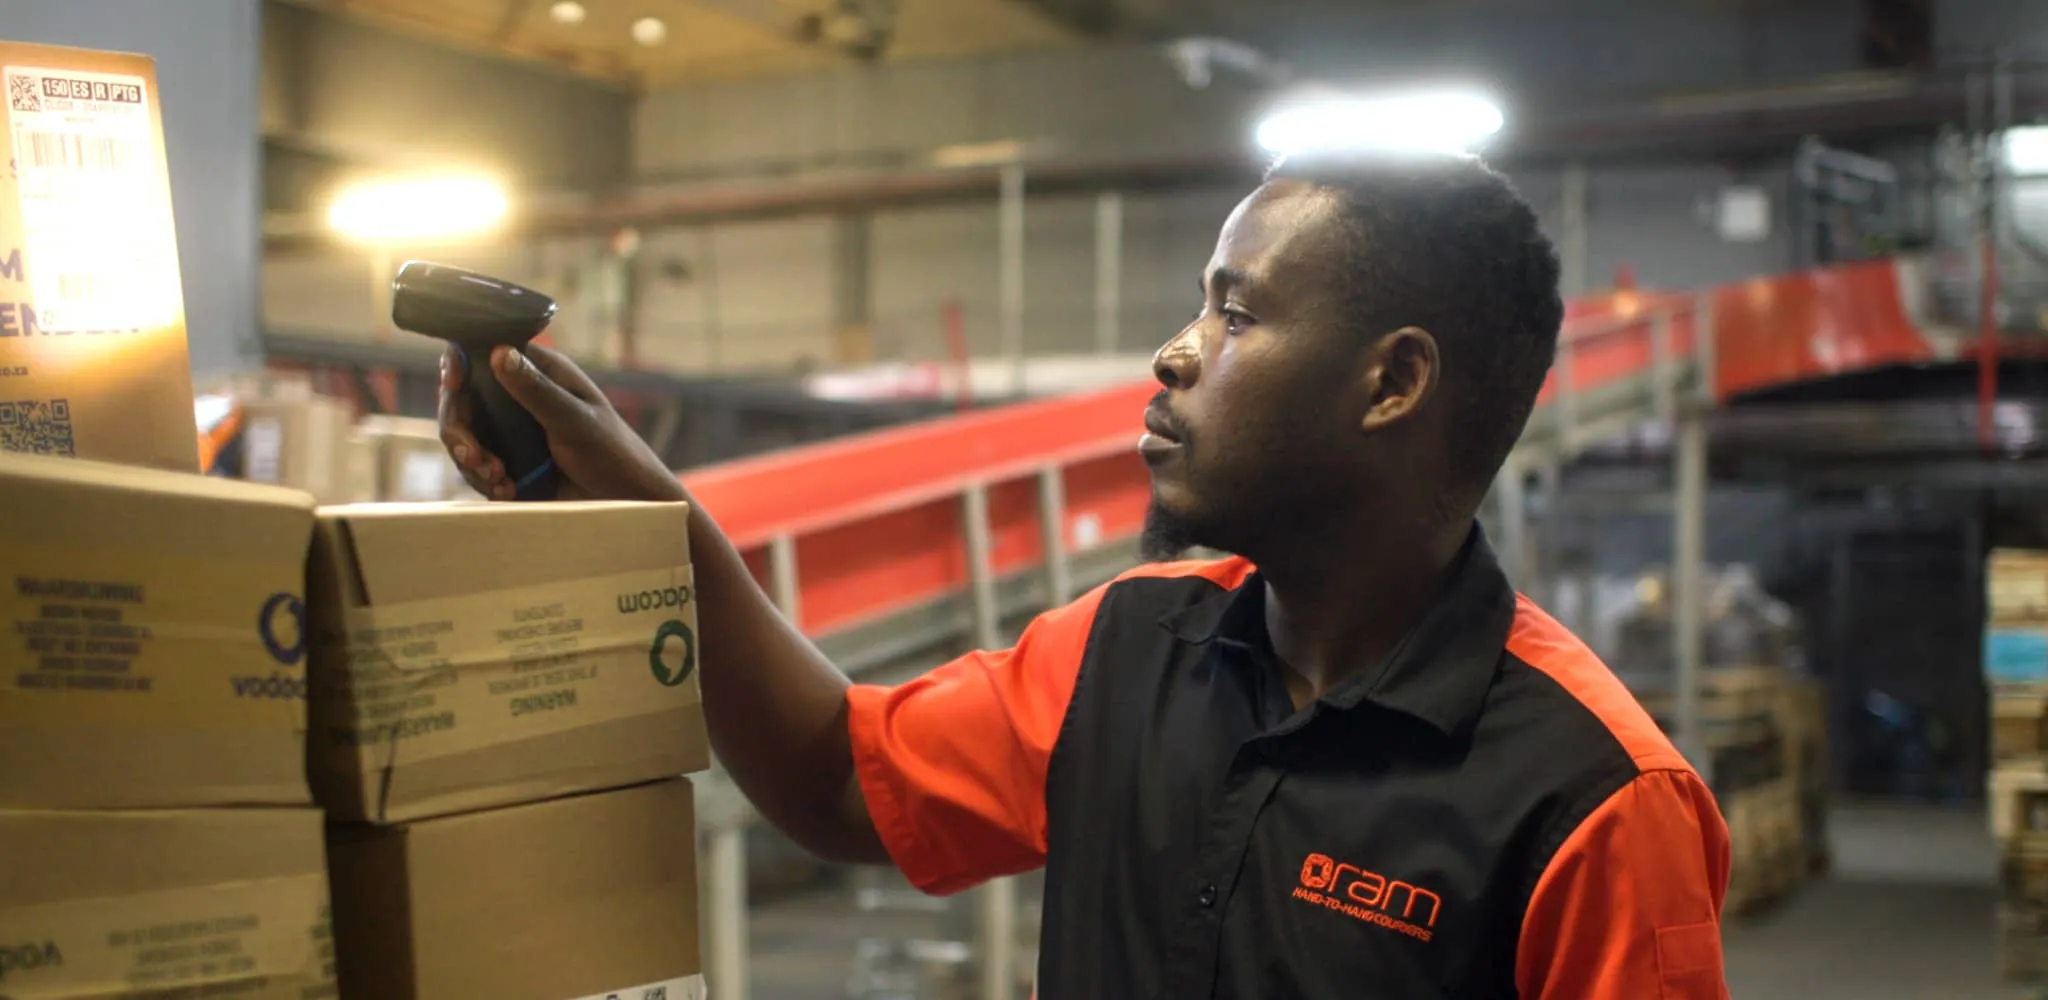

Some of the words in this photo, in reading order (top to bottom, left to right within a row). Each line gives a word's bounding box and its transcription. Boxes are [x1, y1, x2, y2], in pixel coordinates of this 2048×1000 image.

[44, 79, 68, 96] 150
[72, 80, 90, 98] ES
[95, 82, 106, 99] R
[111, 84, 138, 101] PTG
[617, 585, 691, 613] dacom
